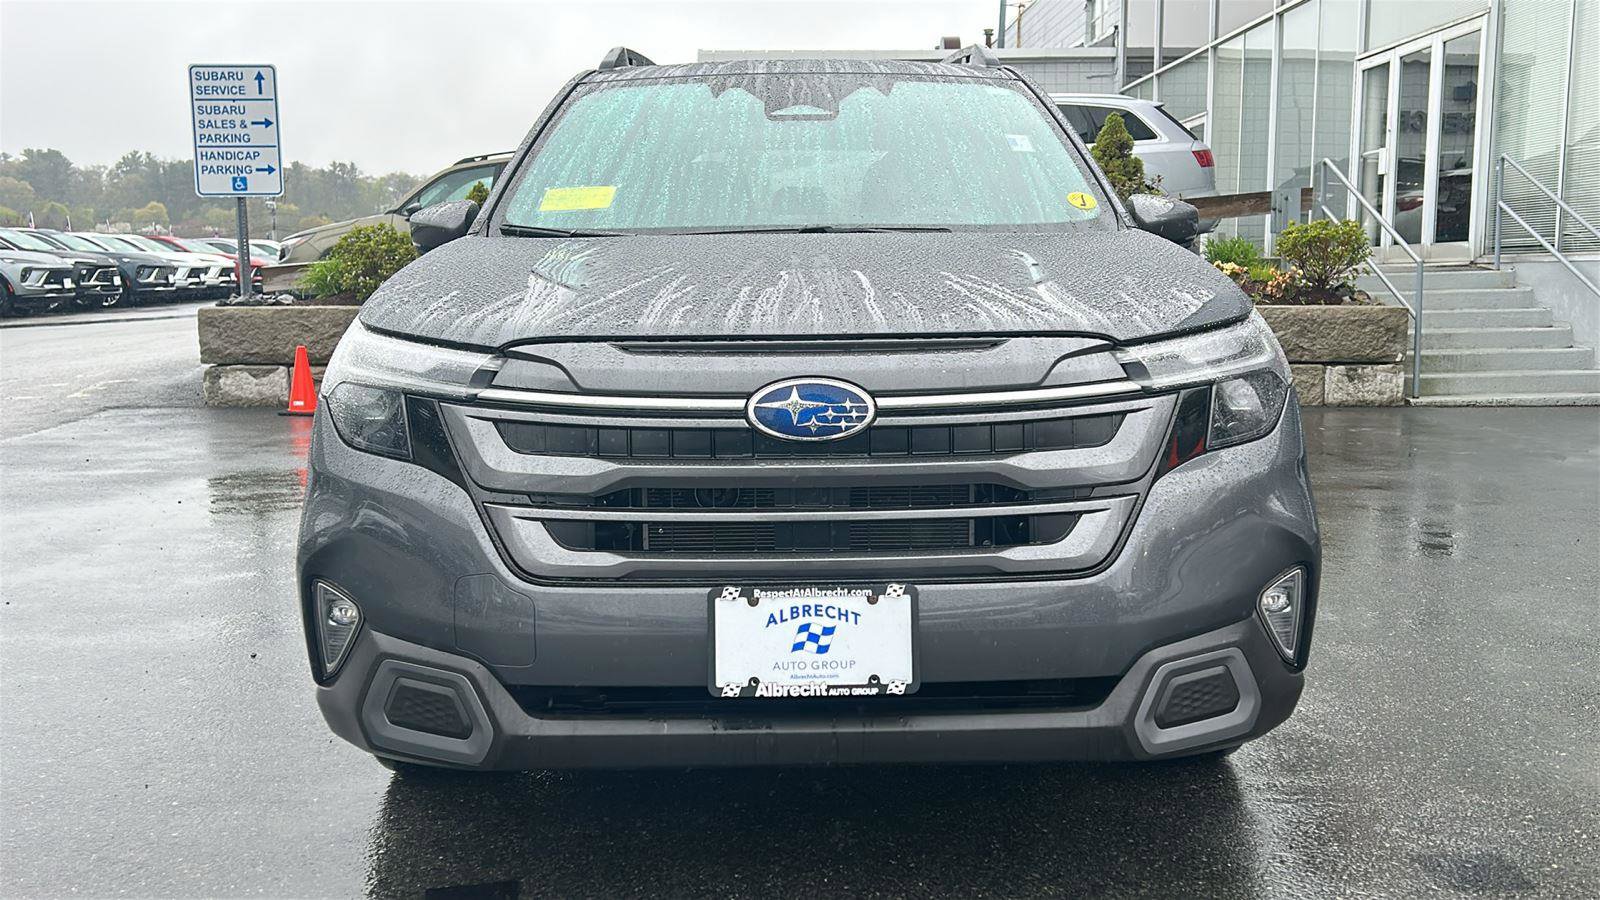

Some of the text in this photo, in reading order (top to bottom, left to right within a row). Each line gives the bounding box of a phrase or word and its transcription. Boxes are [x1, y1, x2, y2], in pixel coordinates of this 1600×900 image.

[195, 71, 244, 81] SUBARU
[196, 85, 246, 95] SERVICE
[197, 105, 246, 115] SUBARU
[198, 119, 248, 129] SALES &
[199, 133, 251, 143] PARKING
[200, 151, 260, 161] HANDICAP
[201, 165, 253, 175] PARKING
[753, 588, 873, 598] RespectAtAlbrecht.com
[765, 604, 861, 628] ALBRECHT
[773, 660, 856, 671] AUTO GROUP
[755, 681, 879, 697] Albrecht AUTO GROUP
